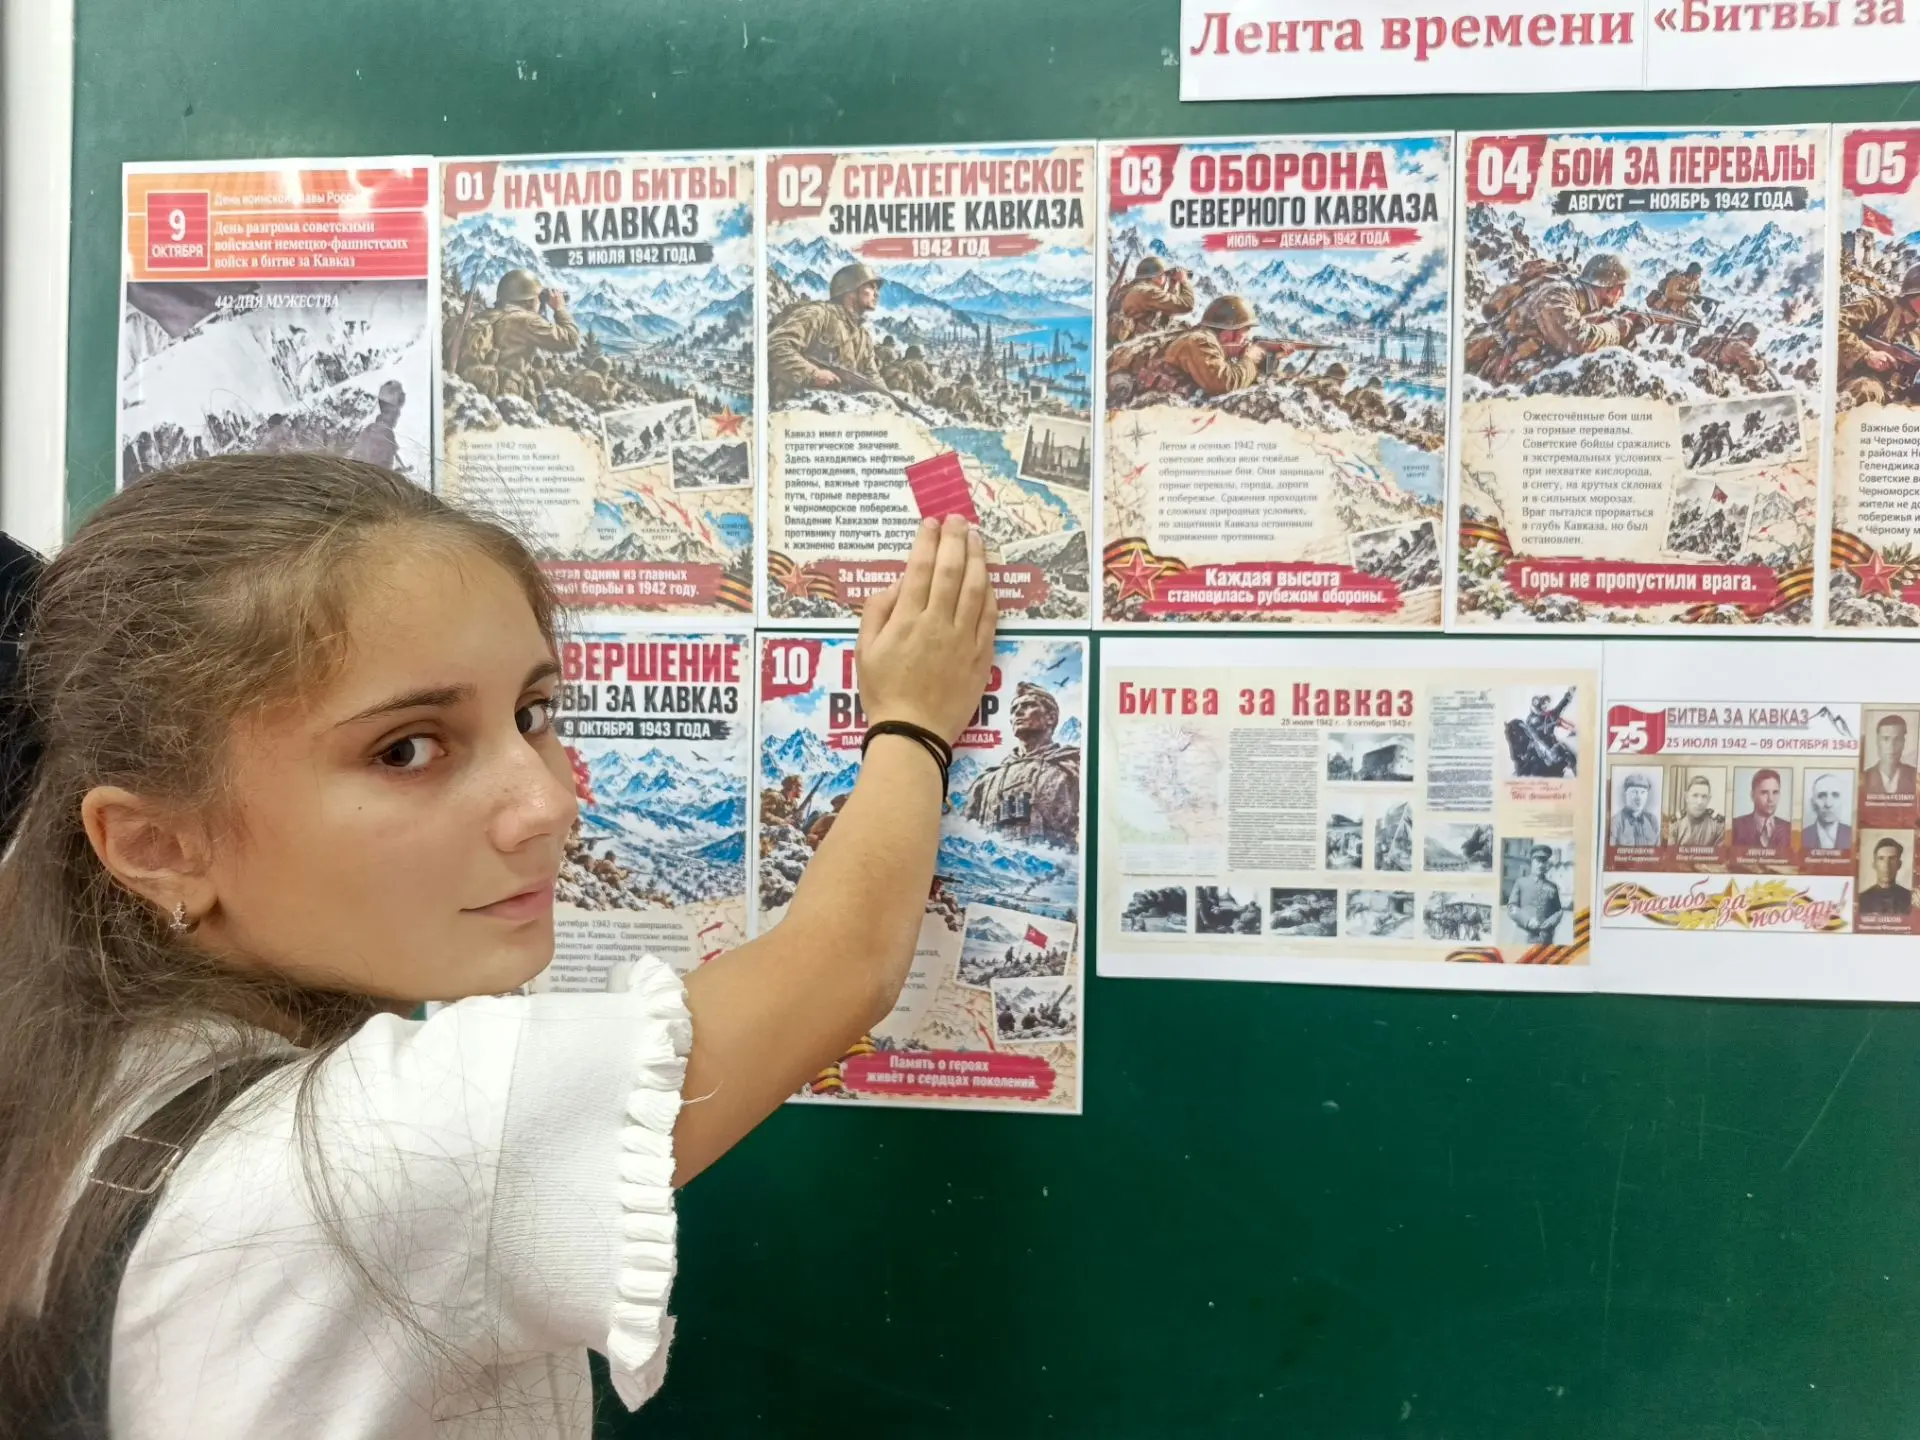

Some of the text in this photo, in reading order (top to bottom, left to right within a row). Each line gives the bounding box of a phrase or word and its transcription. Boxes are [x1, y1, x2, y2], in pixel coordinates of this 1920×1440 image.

[1190, 0, 1905, 61] Лента времени «Битвы за
[1477, 146, 1532, 196] 04
[1551, 144, 1815, 188] БОИ ЗА ПЕРЕВАЛЫ
[1857, 141, 1907, 185] 05
[843, 158, 1085, 199] СТРАТЕГИЧЕСКОЕ
[1120, 155, 1162, 196] 03
[1190, 151, 1388, 194] ОБОРОНА
[455, 171, 484, 201] 01
[504, 166, 737, 210] НАЧАЛО БИТВЫ
[778, 166, 823, 207] 02
[1568, 190, 1793, 212] АВГУСТ НОЯБРЬ 1942 ГОДА
[829, 198, 1084, 235] ЗНАЧЕНИЕ КАВКАЗА
[1170, 193, 1438, 228] СЕВЕРНОГО КАВКАЗА
[168, 209, 186, 241] 9
[215, 222, 375, 237] День разгрома советскими
[535, 204, 698, 245] ЗА КАВКАЗ
[215, 236, 408, 251] войсками немецко-фашистских
[912, 237, 990, 258] 1942 ГОД
[1227, 230, 1390, 249] ИЮЛЬ ДЕКАБРЬ 1942 ГОДА
[152, 244, 203, 258] ОКТЯБРЯ
[568, 247, 696, 265] 25 ИЮЛЯ 1942 ГОДА
[215, 254, 355, 267] войск в битве за Кавказ
[236, 295, 262, 309] ДНЯ
[266, 294, 339, 308] МУЖЕСТВА
[1523, 411, 1604, 421] Ожесточённые
[1608, 412, 1627, 421] бои
[785, 429, 816, 438] Кавказ
[846, 431, 888, 440] огромное
[1537, 427, 1576, 436] горные
[1580, 427, 1633, 436] перевалы.
[1861, 423, 1920, 433] Важные бои
[785, 443, 854, 451] стратегическое
[1235, 441, 1254, 450] 1942
[1257, 443, 1277, 451] года
[1523, 437, 1671, 450] Советские бойцы сражались
[785, 454, 915, 465] Здесь находились нефтяные
[1868, 448, 1907, 459] районах
[785, 468, 858, 476] месторождения,
[1522, 468, 1542, 477] при
[1859, 461, 1920, 471] Геленджика
[1859, 473, 1909, 483] Советские
[785, 492, 890, 502] пути, горные перевалы
[793, 505, 856, 514] черноморское
[860, 503, 910, 514] побережье.
[1522, 507, 1546, 518] Враг
[1595, 509, 1653, 518] прорваться
[1858, 511, 1912, 522] побережья
[785, 515, 832, 525] Овладение
[836, 516, 878, 524] Кавказом
[1522, 536, 1583, 544] остановлен.
[584, 570, 619, 582] одним
[624, 571, 636, 580] из
[639, 570, 687, 581] главных
[838, 569, 896, 584] За Кавказ
[1003, 572, 1031, 587] один
[1206, 568, 1339, 588] Каждая высота
[1521, 567, 1757, 595] Горы не пропустили врага.
[582, 582, 699, 598] борьбы в 1942 году.
[847, 587, 861, 598] из
[1168, 587, 1386, 606] становилась рубежом обороны.
[562, 643, 740, 682] ВЕРШЕНИЕ
[772, 646, 809, 685] 10
[606, 685, 635, 712] ЗА
[644, 686, 738, 714] КАВКАЗ
[1119, 682, 1414, 717] Битва за Кавказ
[1667, 708, 1809, 725] БИТВА ЗА КАВКАЗ
[564, 721, 710, 737] 9 ОКТЯБРЯ 1943 ГОДА
[842, 734, 994, 745] ПАМ АВКАЗА
[1667, 737, 1858, 750] 25 ИЮЛЯ 1942 09 ОКТЯБРЯ 1943
[1602, 875, 1709, 918] Спасибо
[1716, 891, 1748, 930] за
[890, 1055, 989, 1072] Память о героях
[867, 1071, 1038, 1088] живёт в сердцах поколений.
